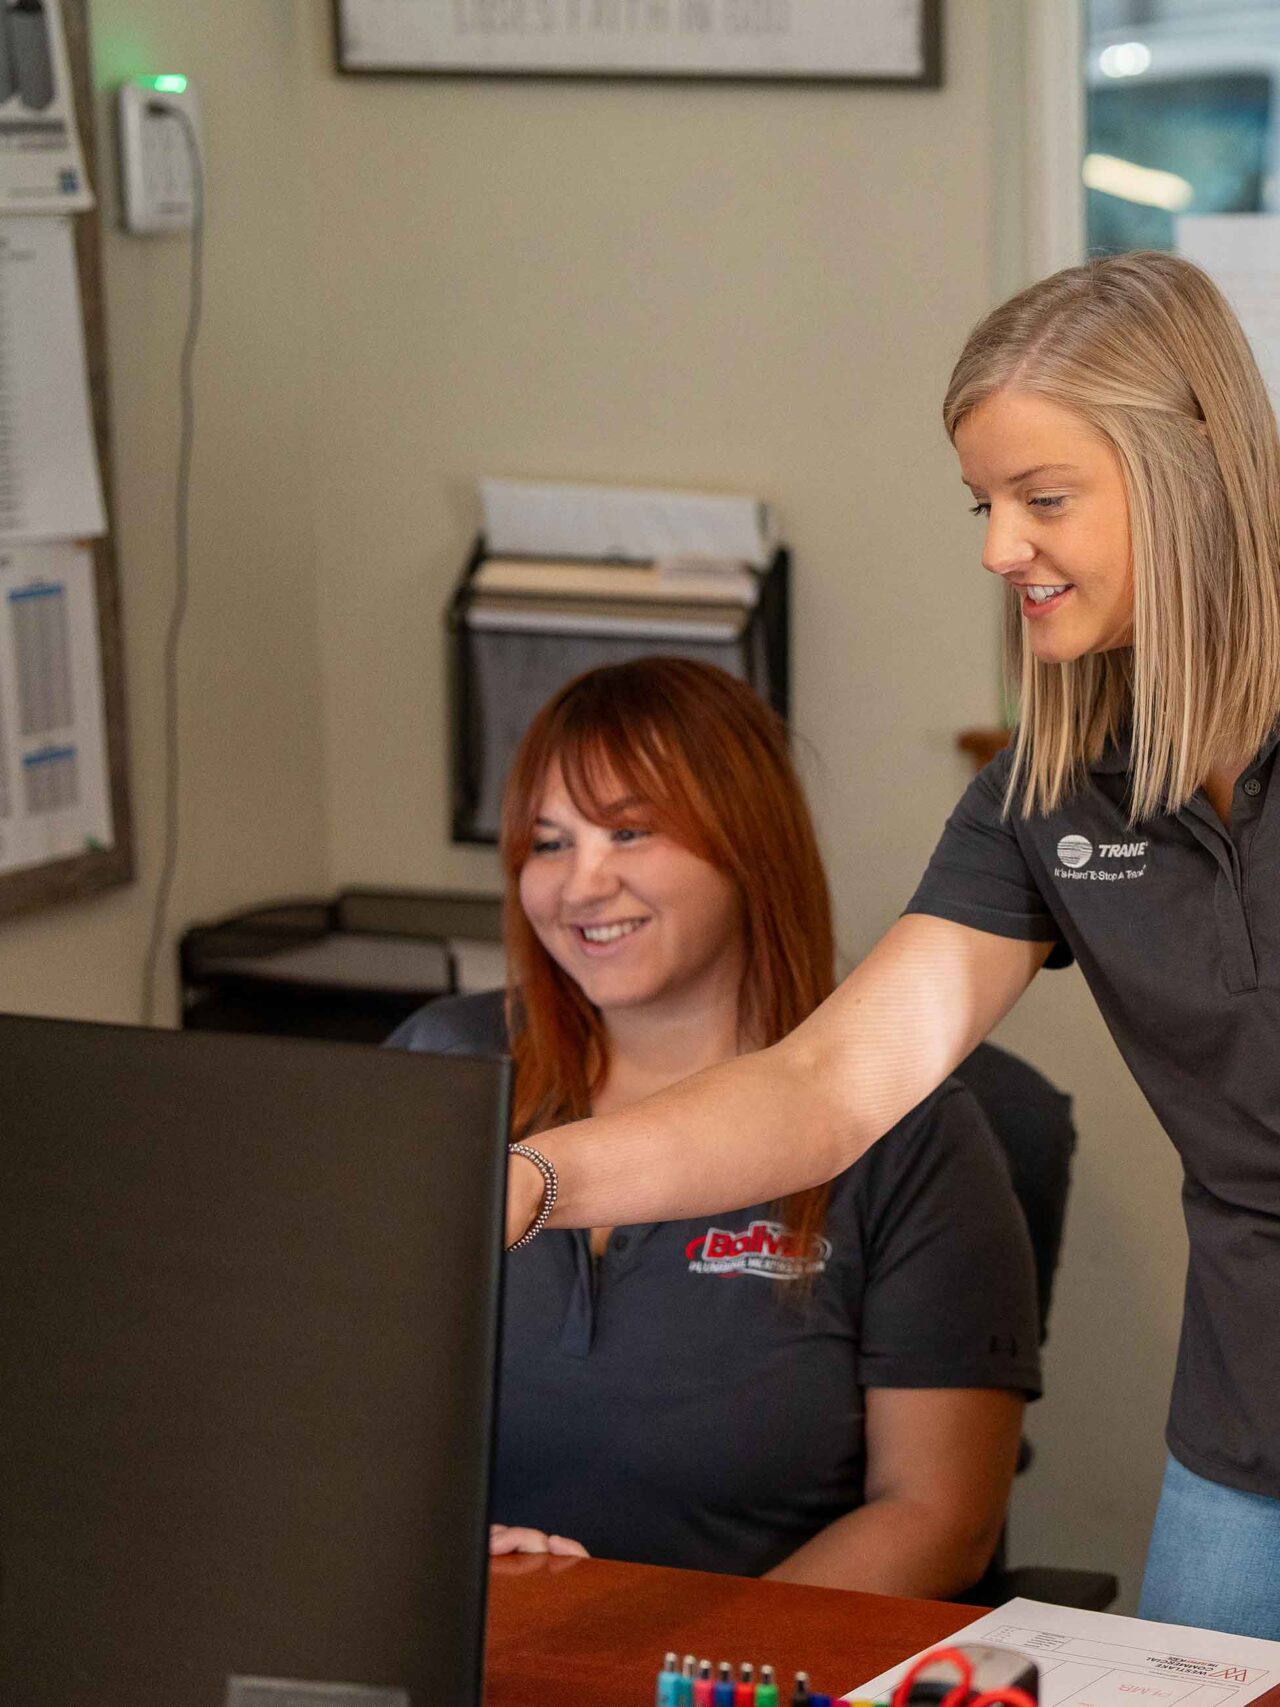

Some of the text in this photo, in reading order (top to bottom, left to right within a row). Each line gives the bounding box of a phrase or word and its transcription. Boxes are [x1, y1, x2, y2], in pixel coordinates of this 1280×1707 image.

[1098, 841, 1146, 858] TRANE
[1098, 870, 1117, 882] Stop
[1118, 871, 1125, 880] A
[1146, 1656, 1214, 1671] COMMERCIAL
[1155, 1664, 1207, 1675] WESTLAKE
